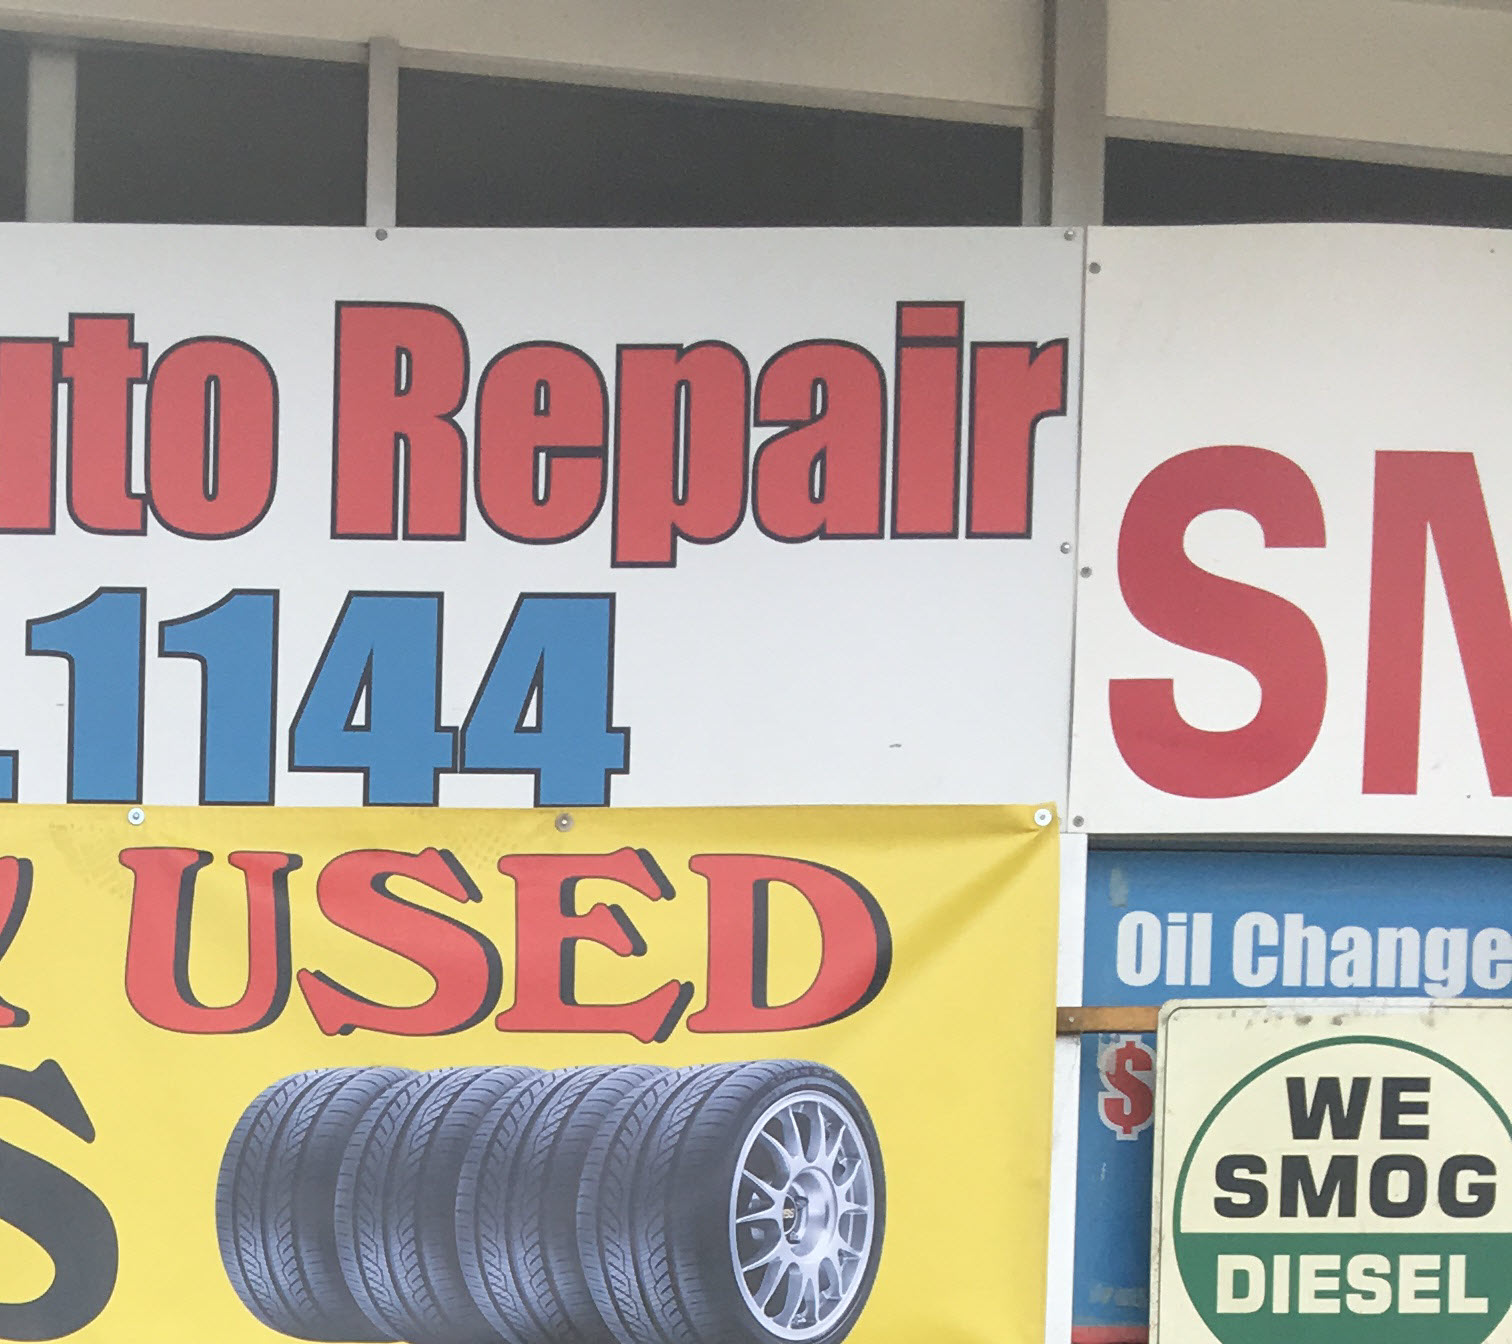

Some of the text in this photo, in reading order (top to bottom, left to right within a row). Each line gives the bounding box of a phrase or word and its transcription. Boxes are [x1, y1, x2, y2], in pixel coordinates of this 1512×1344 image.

[328, 300, 1068, 568] Repair
[118, 846, 894, 1044] USED
[1115, 910, 1512, 997] Oil Change
[1285, 1076, 1431, 1141] WE
[1213, 1153, 1497, 1219] SMOG
[1216, 1253, 1490, 1315] DIESEL
